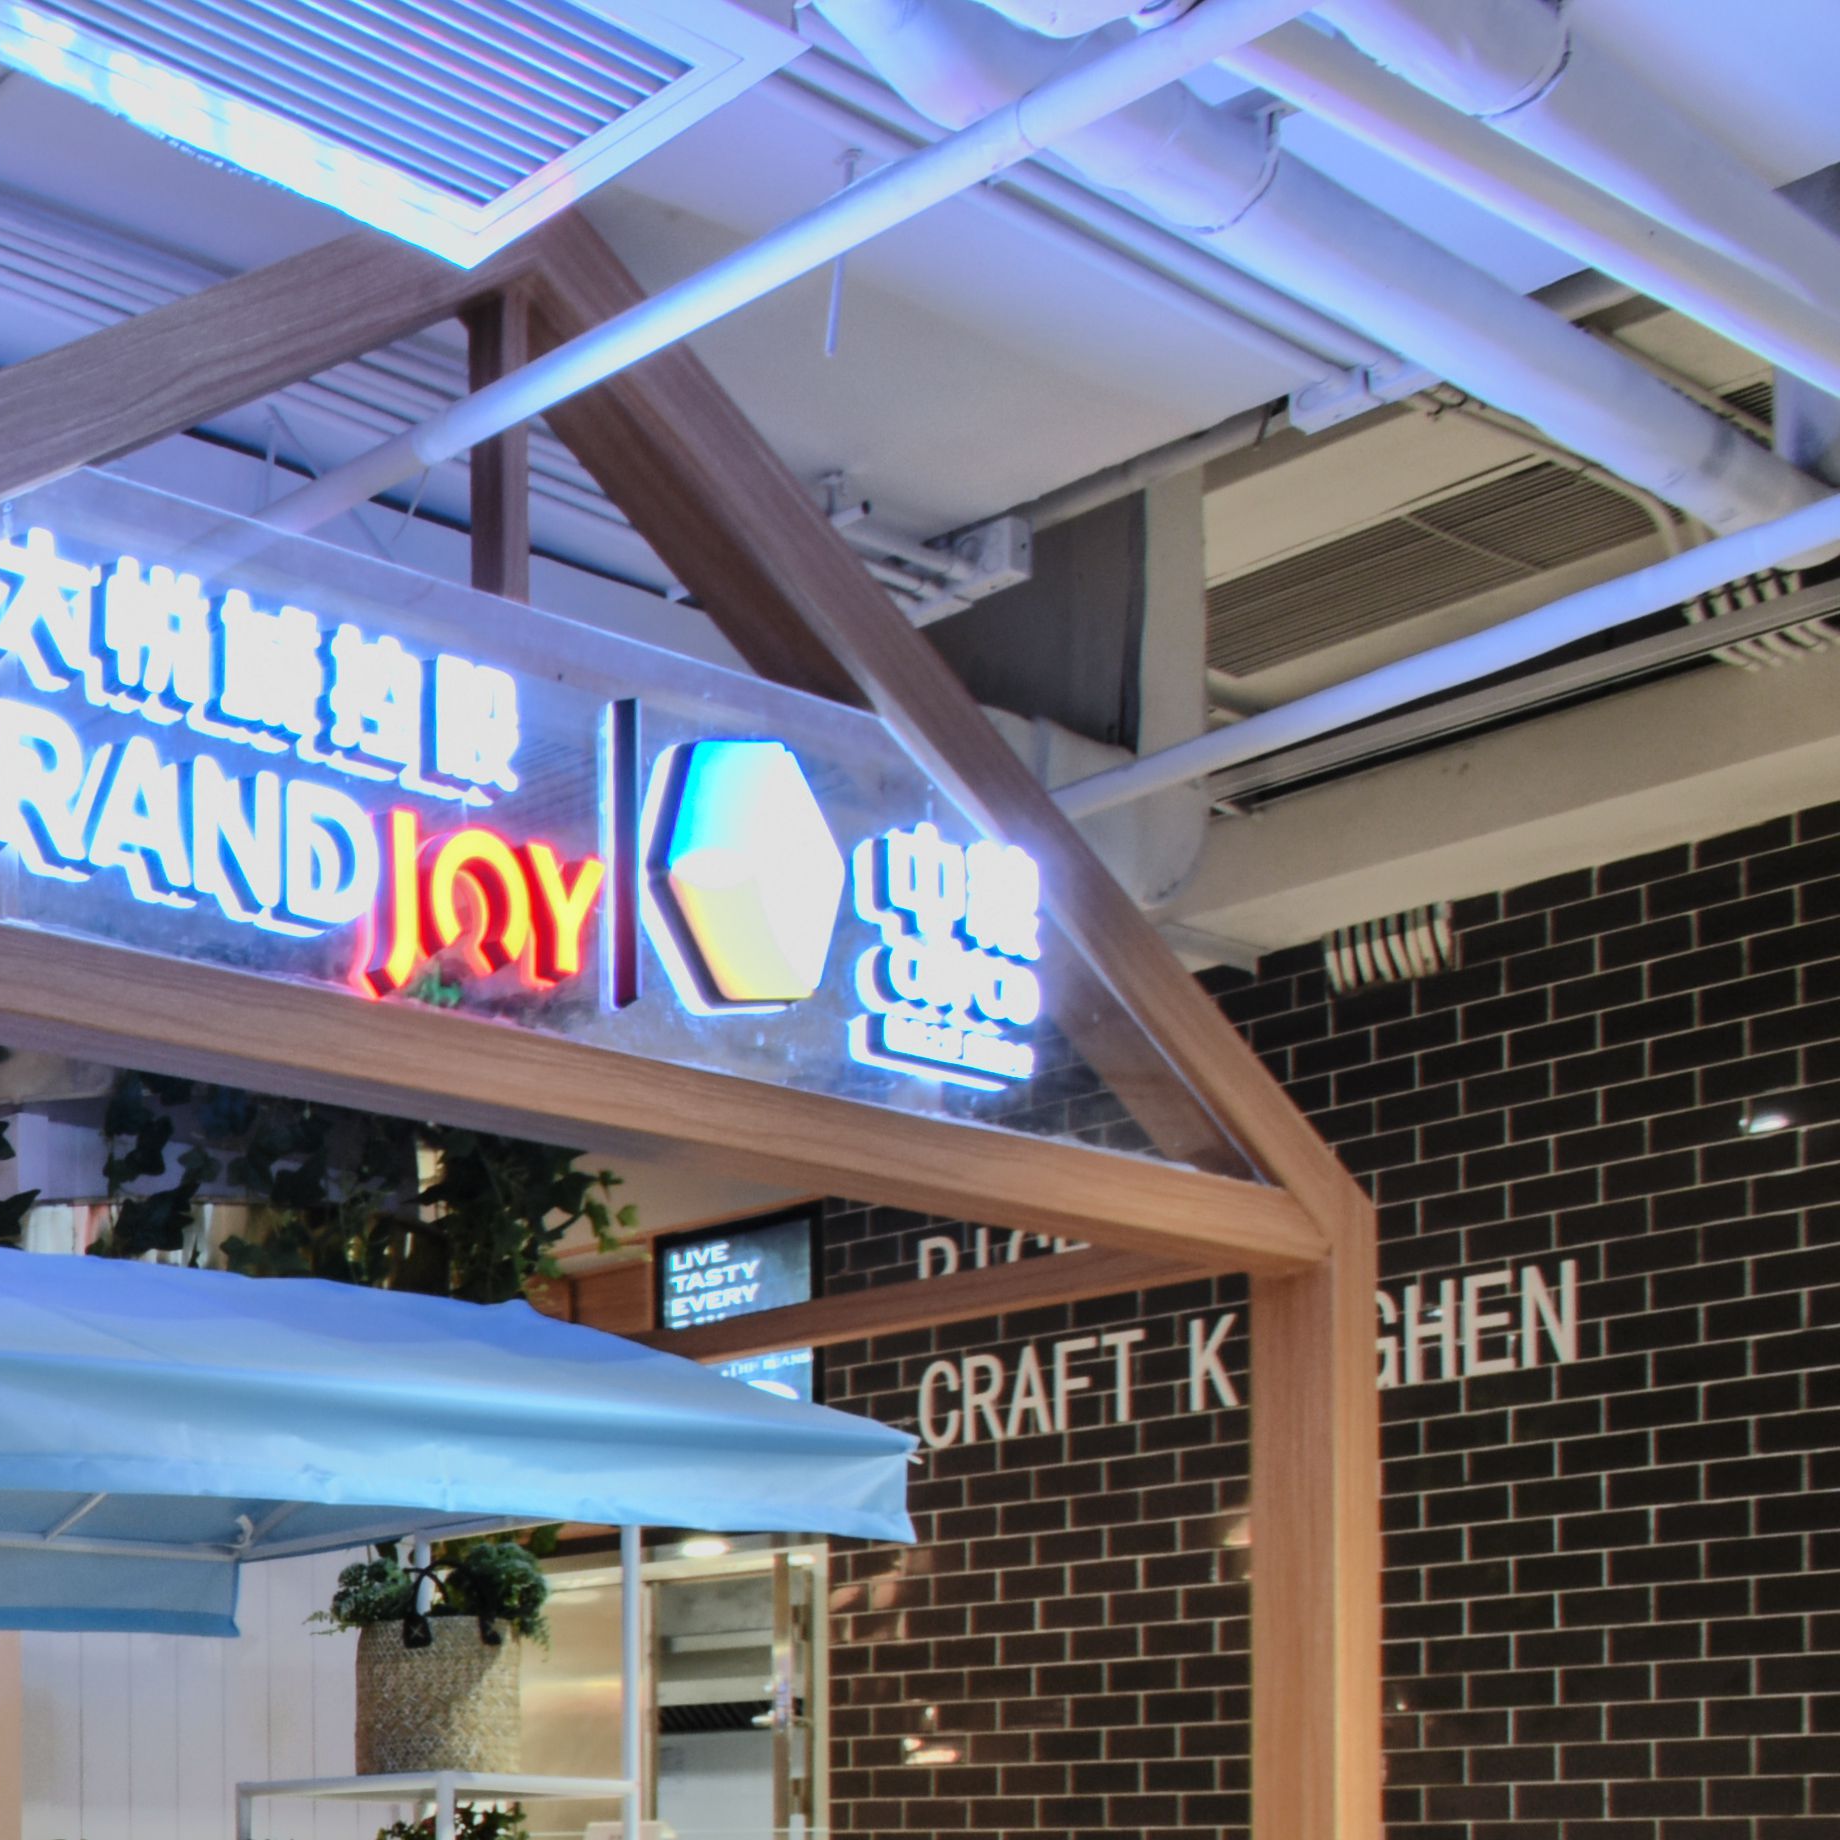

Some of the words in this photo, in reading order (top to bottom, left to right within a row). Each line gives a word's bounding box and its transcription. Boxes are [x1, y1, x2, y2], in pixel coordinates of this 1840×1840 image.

[671, 1241, 729, 1272] LIVE
[671, 1258, 760, 1293] TASTY
[671, 1283, 760, 1317] EVERY
[920, 1329, 1145, 1449] CRAFT
